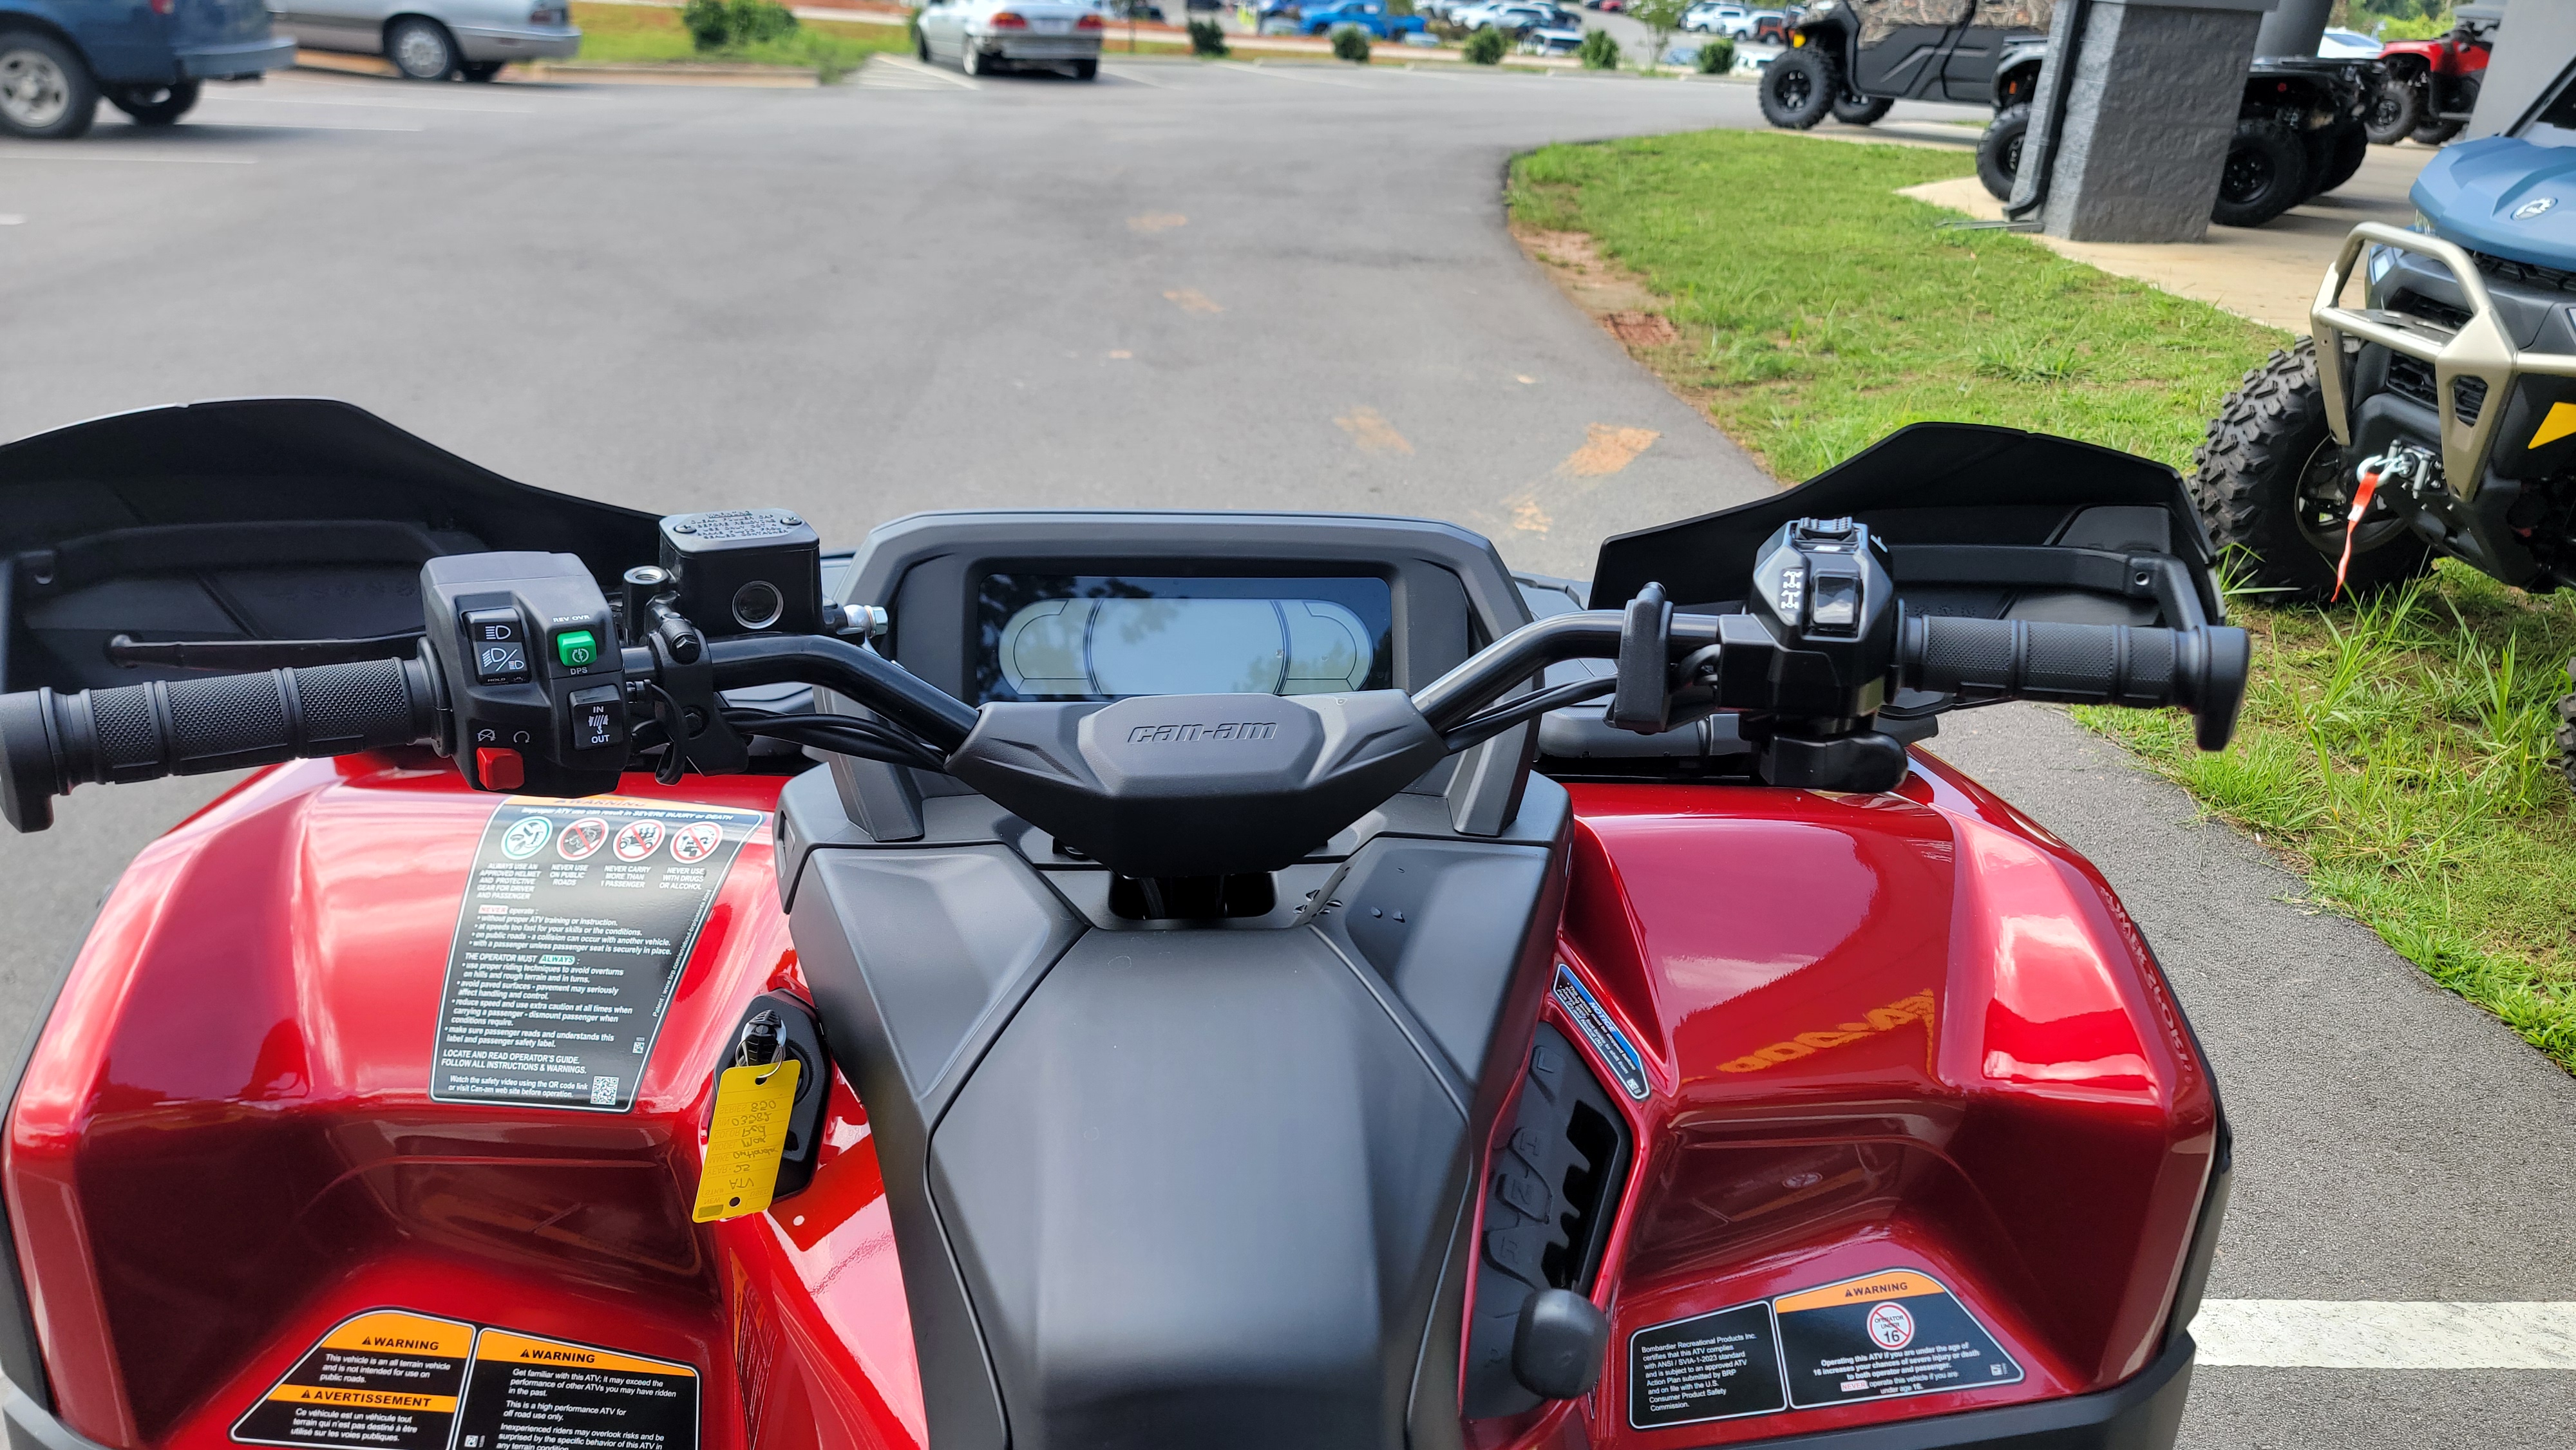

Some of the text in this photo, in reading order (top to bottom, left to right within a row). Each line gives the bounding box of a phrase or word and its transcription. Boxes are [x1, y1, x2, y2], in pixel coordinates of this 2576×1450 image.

[591, 735, 610, 743] OUT
[1127, 722, 1278, 744] can-am
[671, 881, 702, 890] ALCOHOL
[1589, 1002, 1617, 1033] NOTICE
[443, 1050, 471, 1059] LOCATE
[472, 1051, 487, 1059] AND
[509, 1053, 554, 1062] OPERATOR'S
[556, 1055, 580, 1064] GUIDE.
[441, 1059, 473, 1068] FOLLOW
[487, 1061, 538, 1071] INSTRUCTIONS
[547, 1064, 587, 1074] WARNINGS.
[481, 1077, 500, 1087] safety
[519, 1080, 536, 1089] using
[1853, 1283, 1908, 1296] WARNING
[1884, 1330, 1900, 1343] 16
[374, 1337, 440, 1350] WARNING
[1642, 1344, 1676, 1353] Bombardier
[1678, 1338, 1716, 1348] Recreational
[1717, 1335, 1744, 1343] Products
[1707, 1345, 1734, 1353] complies
[326, 1353, 341, 1362] This
[343, 1355, 368, 1364] vehicle
[400, 1359, 423, 1368] terrain
[425, 1361, 451, 1370] vehicle
[533, 1350, 596, 1363] WARNING
[1678, 1354, 1718, 1365] SVIA-1-2023
[1719, 1351, 1745, 1360] standard
[1821, 1357, 1854, 1368] Operating
[1869, 1353, 1883, 1361] ATV
[361, 1366, 392, 1375] intended
[528, 1370, 554, 1379] familiar
[571, 1373, 583, 1381] this
[585, 1374, 602, 1383] ATV;
[320, 1374, 342, 1382] public
[510, 1379, 556, 1388] performance
[585, 1384, 604, 1392] ATVs
[637, 1388, 654, 1396] have
[655, 1389, 676, 1397] ridden
[314, 1391, 431, 1407] AVERTISSEMENT
[1649, 1395, 1680, 1403] Consumer
[1681, 1390, 1705, 1399] Product
[538, 1402, 553, 1411] high
[554, 1404, 599, 1413] performance
[296, 1408, 307, 1416] Ce
[309, 1408, 339, 1418] véhicule
[341, 1411, 352, 1419] est
[366, 1413, 395, 1422] véhicule
[397, 1415, 412, 1423] tout
